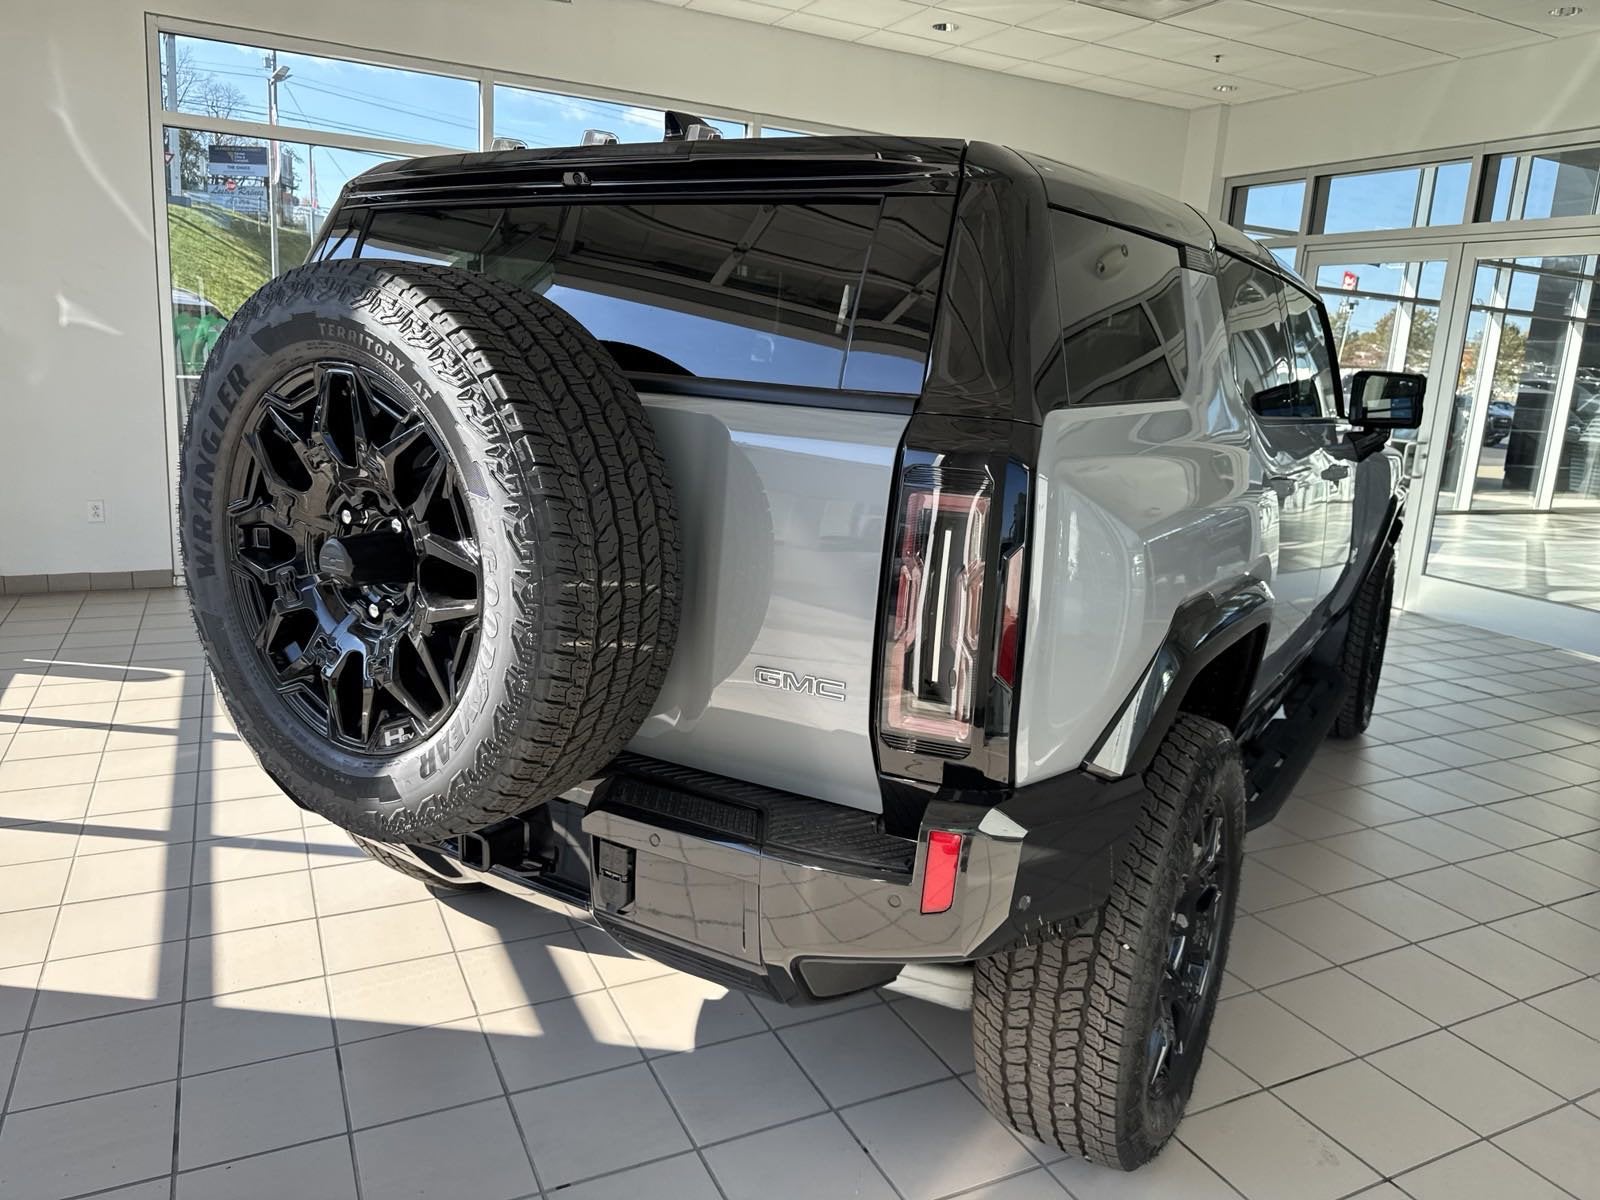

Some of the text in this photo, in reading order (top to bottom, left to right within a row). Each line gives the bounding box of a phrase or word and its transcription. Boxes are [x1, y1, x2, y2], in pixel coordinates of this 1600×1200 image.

[318, 323, 405, 371] TERRITORY
[413, 380, 432, 401] AT
[192, 363, 250, 578] WRANGLER
[754, 665, 846, 702] GMC
